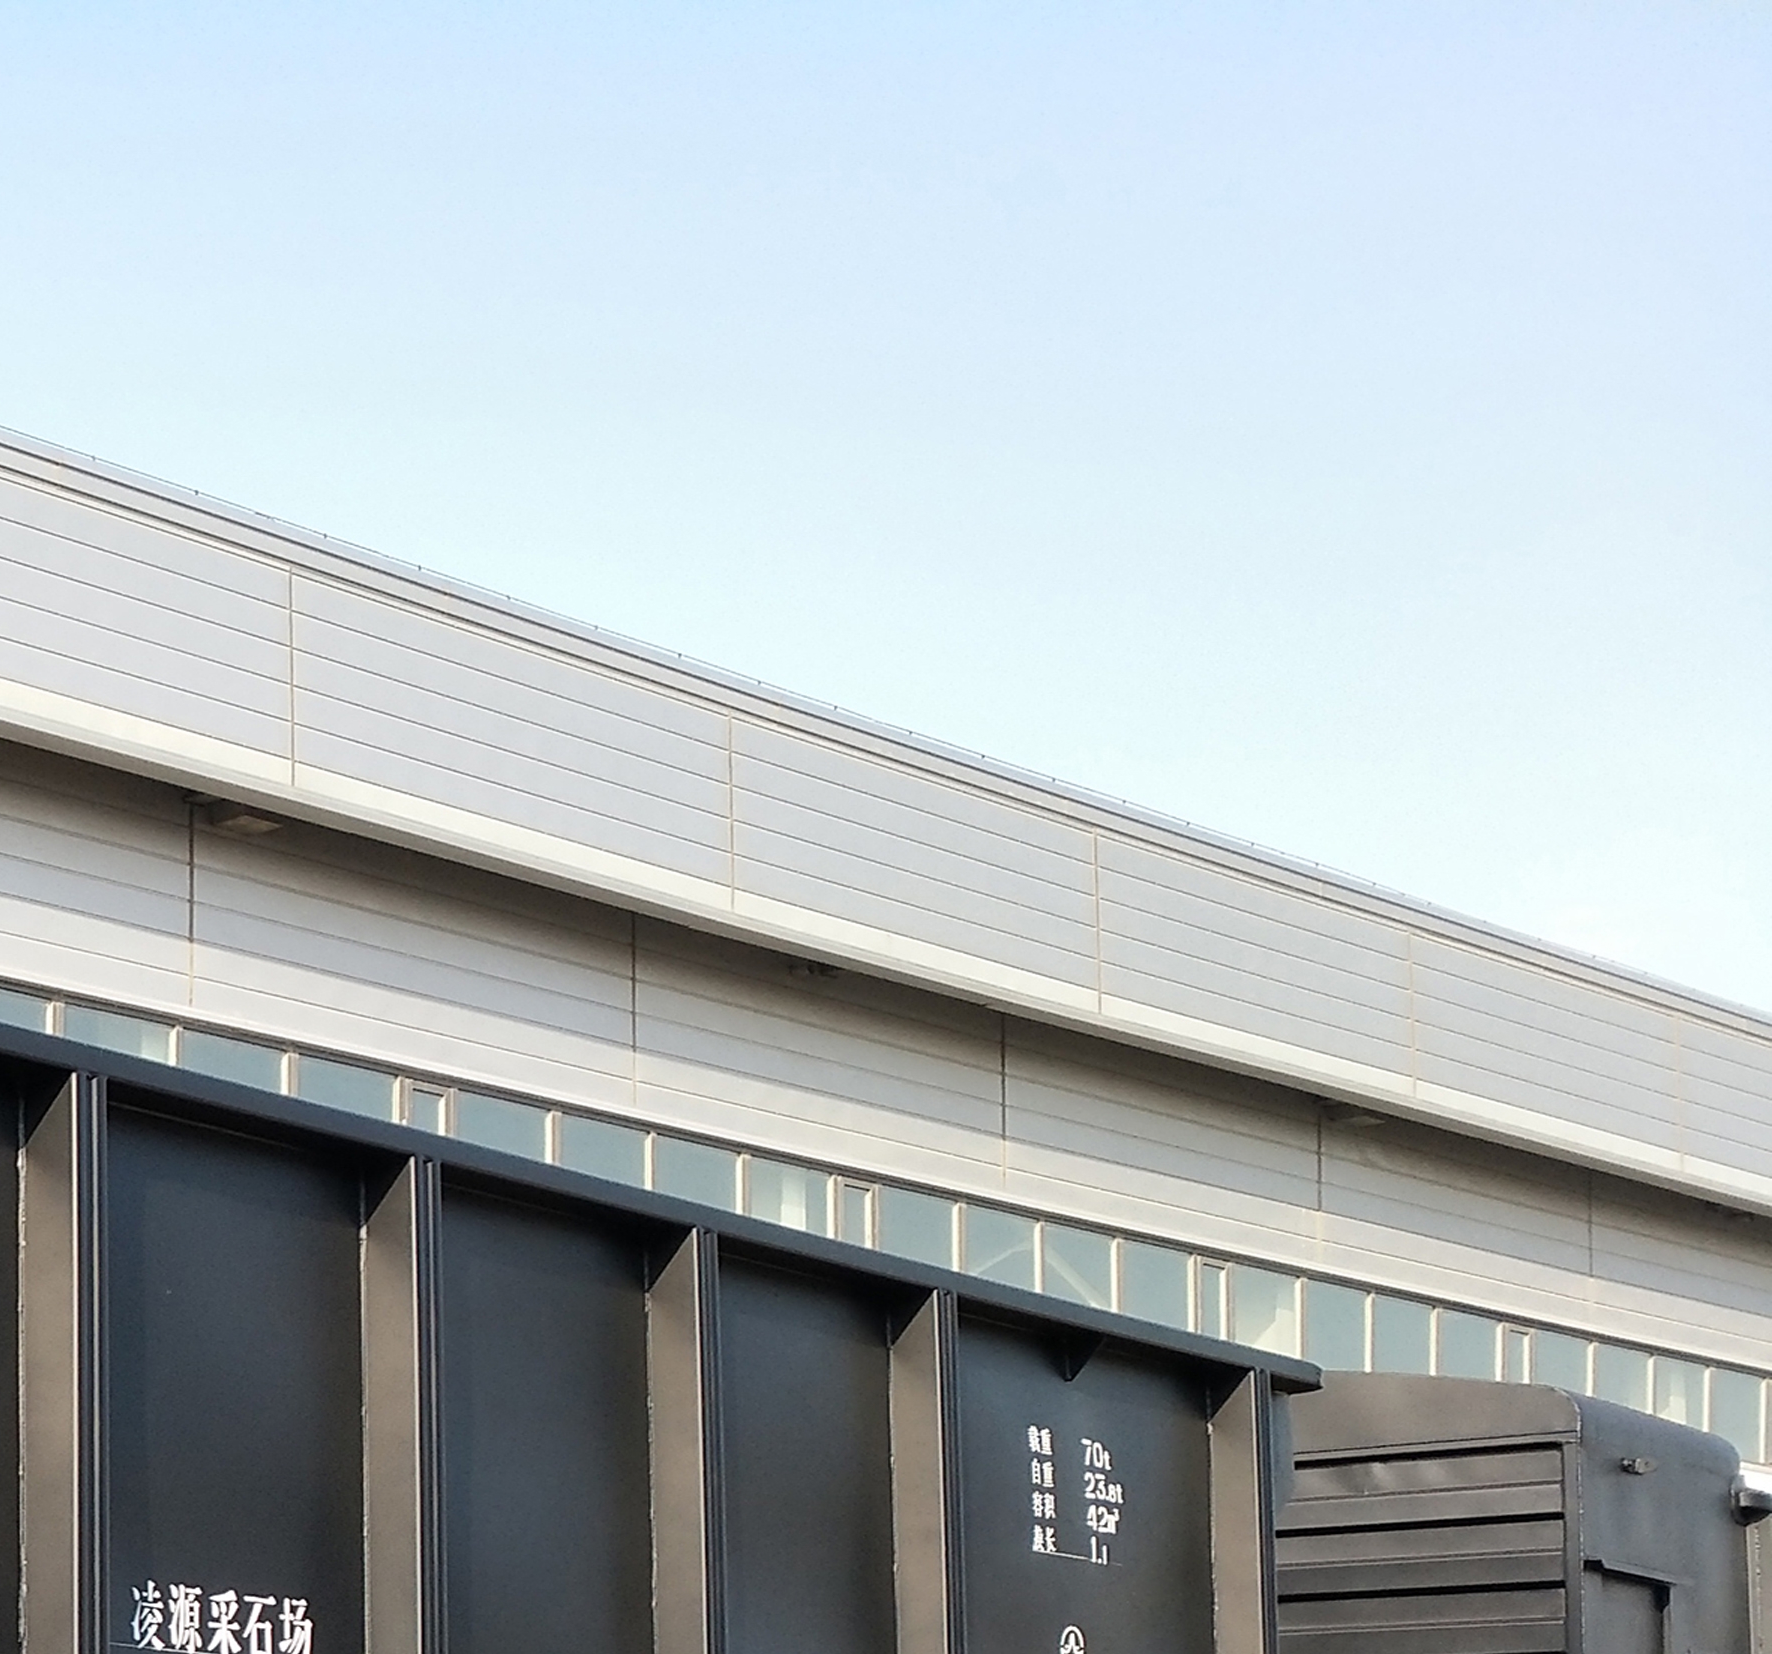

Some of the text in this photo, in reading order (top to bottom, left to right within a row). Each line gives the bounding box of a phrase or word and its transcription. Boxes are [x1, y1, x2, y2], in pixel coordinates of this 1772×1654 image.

[1080, 1437, 1112, 1471] 70t
[1031, 1457, 1124, 1504] 自重 23.8t
[1090, 1535, 1108, 1566] 1.1
